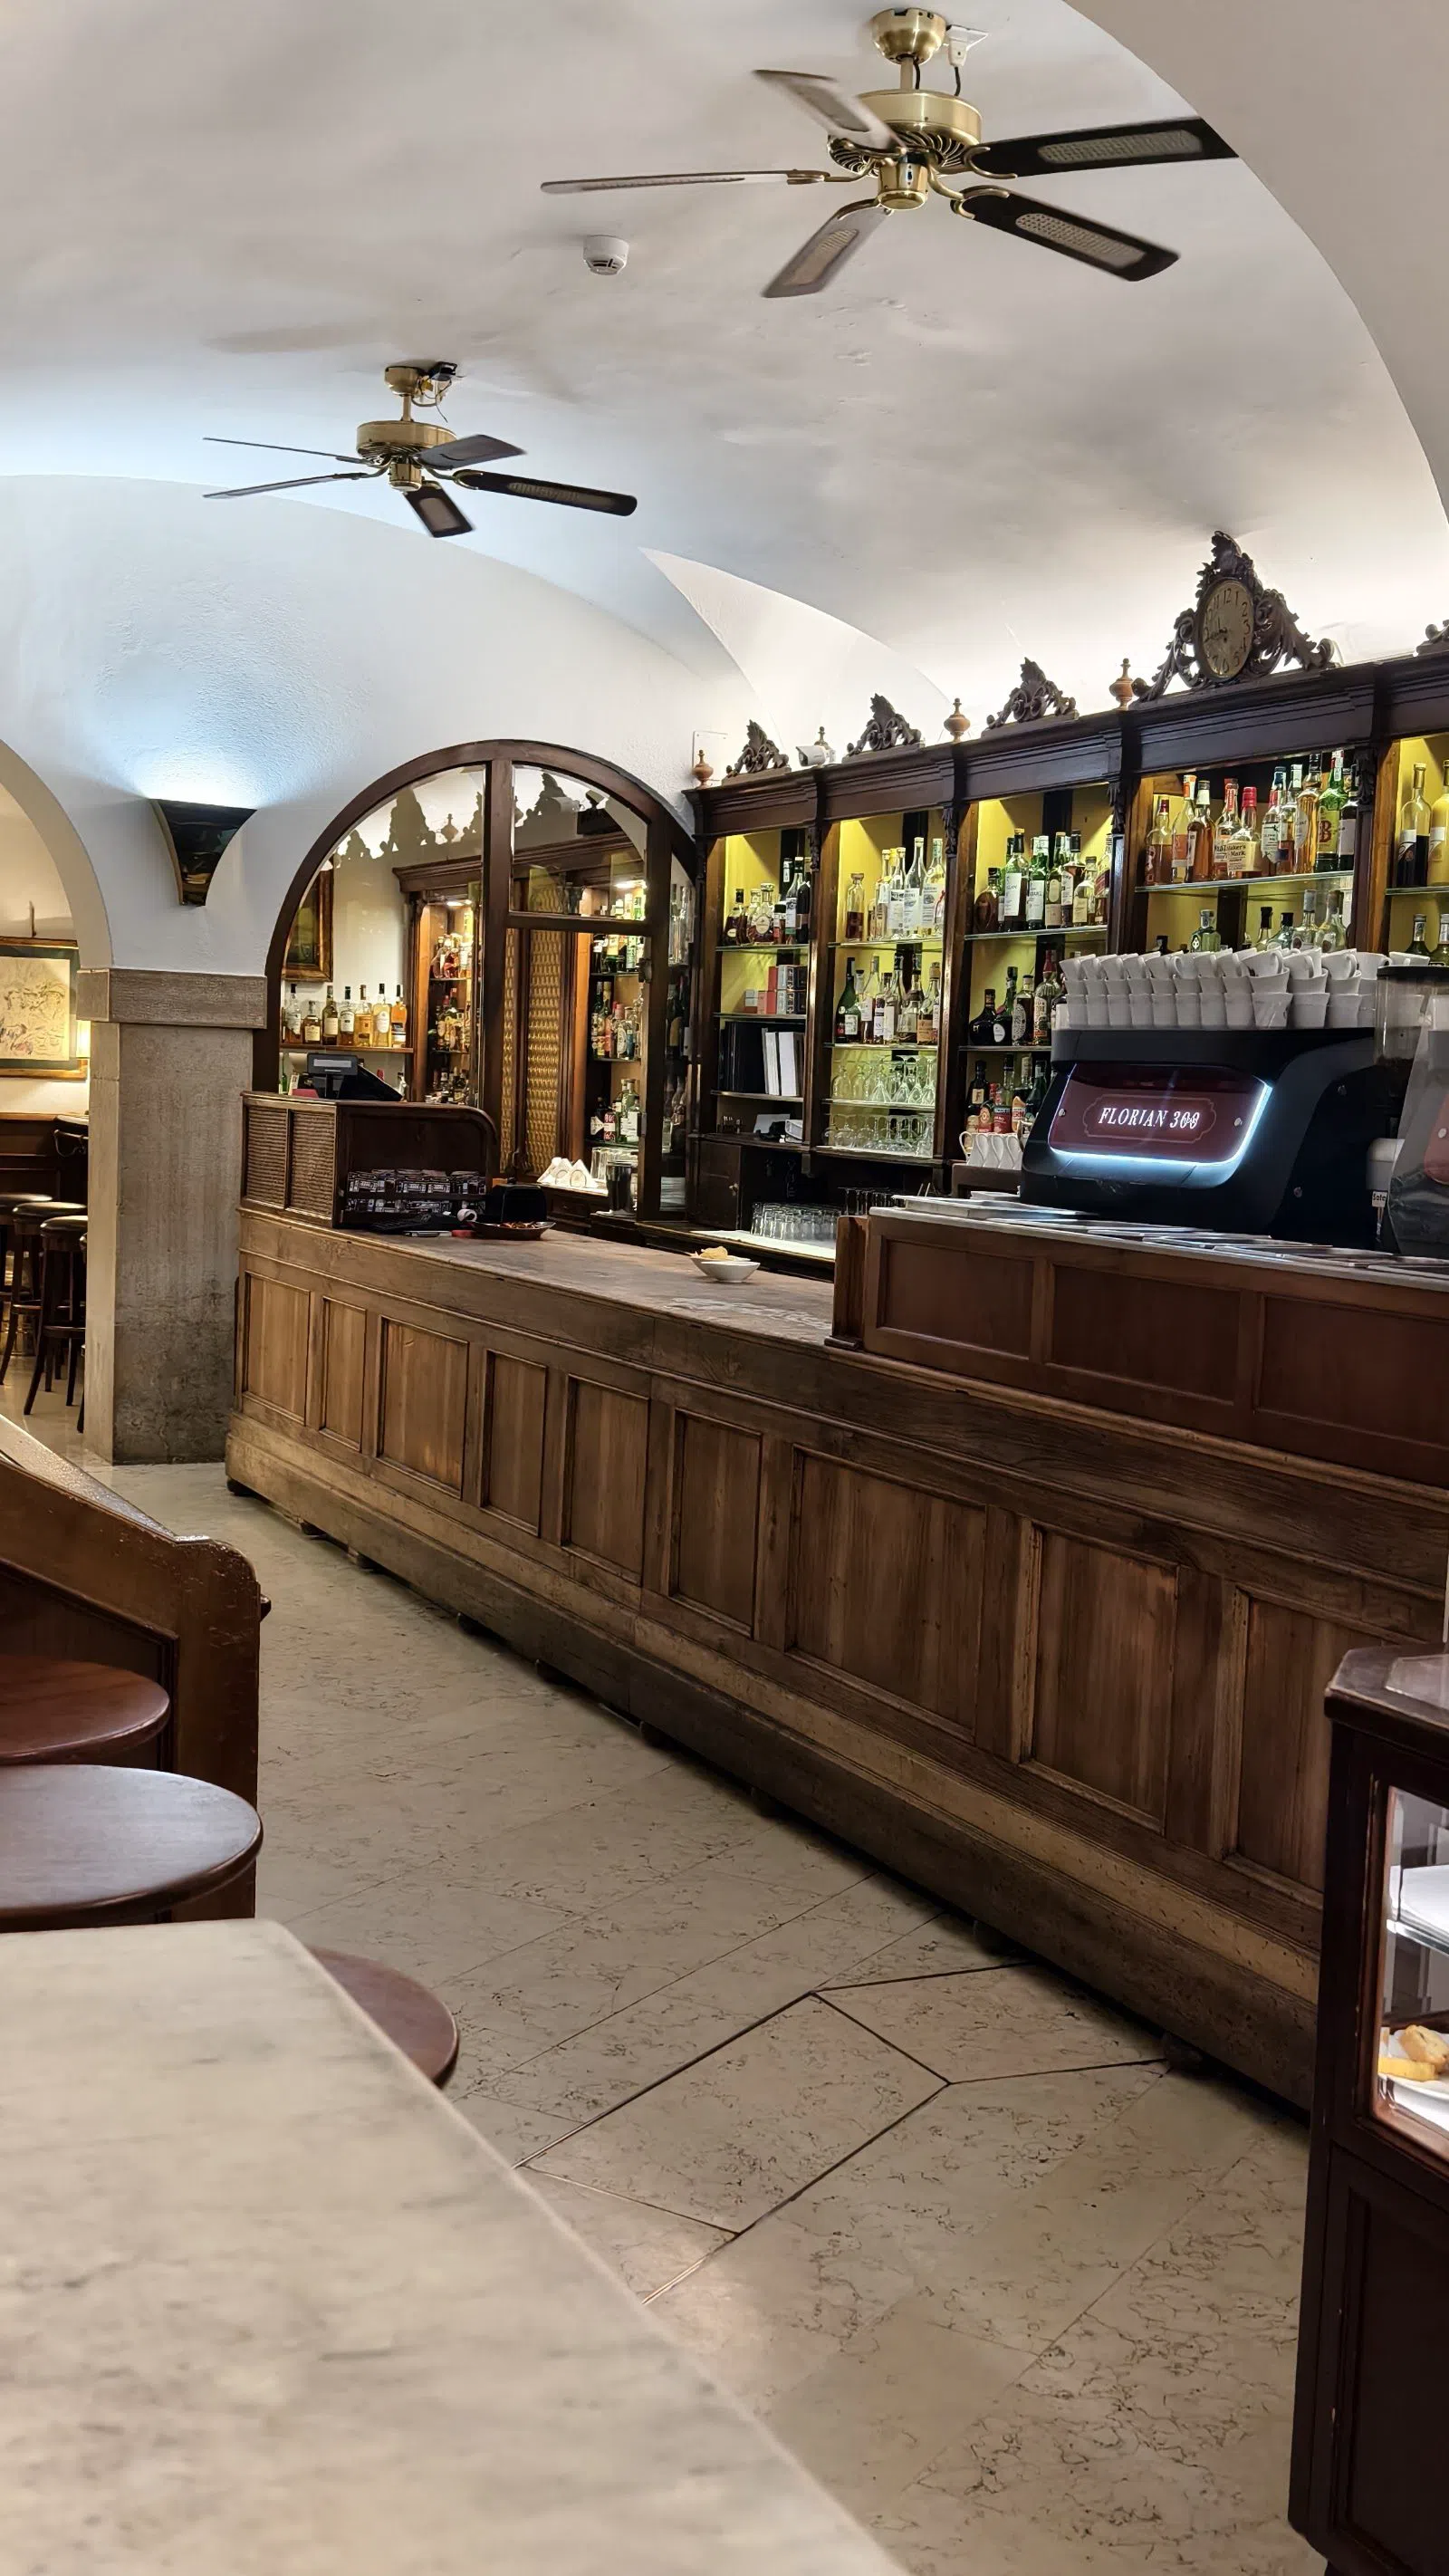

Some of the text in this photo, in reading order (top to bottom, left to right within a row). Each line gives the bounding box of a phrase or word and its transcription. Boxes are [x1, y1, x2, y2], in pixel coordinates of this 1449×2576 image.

[1223, 588, 1232, 605] 12
[1242, 601, 1248, 617] 2
[1243, 619, 1251, 635] 3
[1240, 637, 1247, 653] 4
[1098, 1107, 1201, 1129] FLORIAN 300
